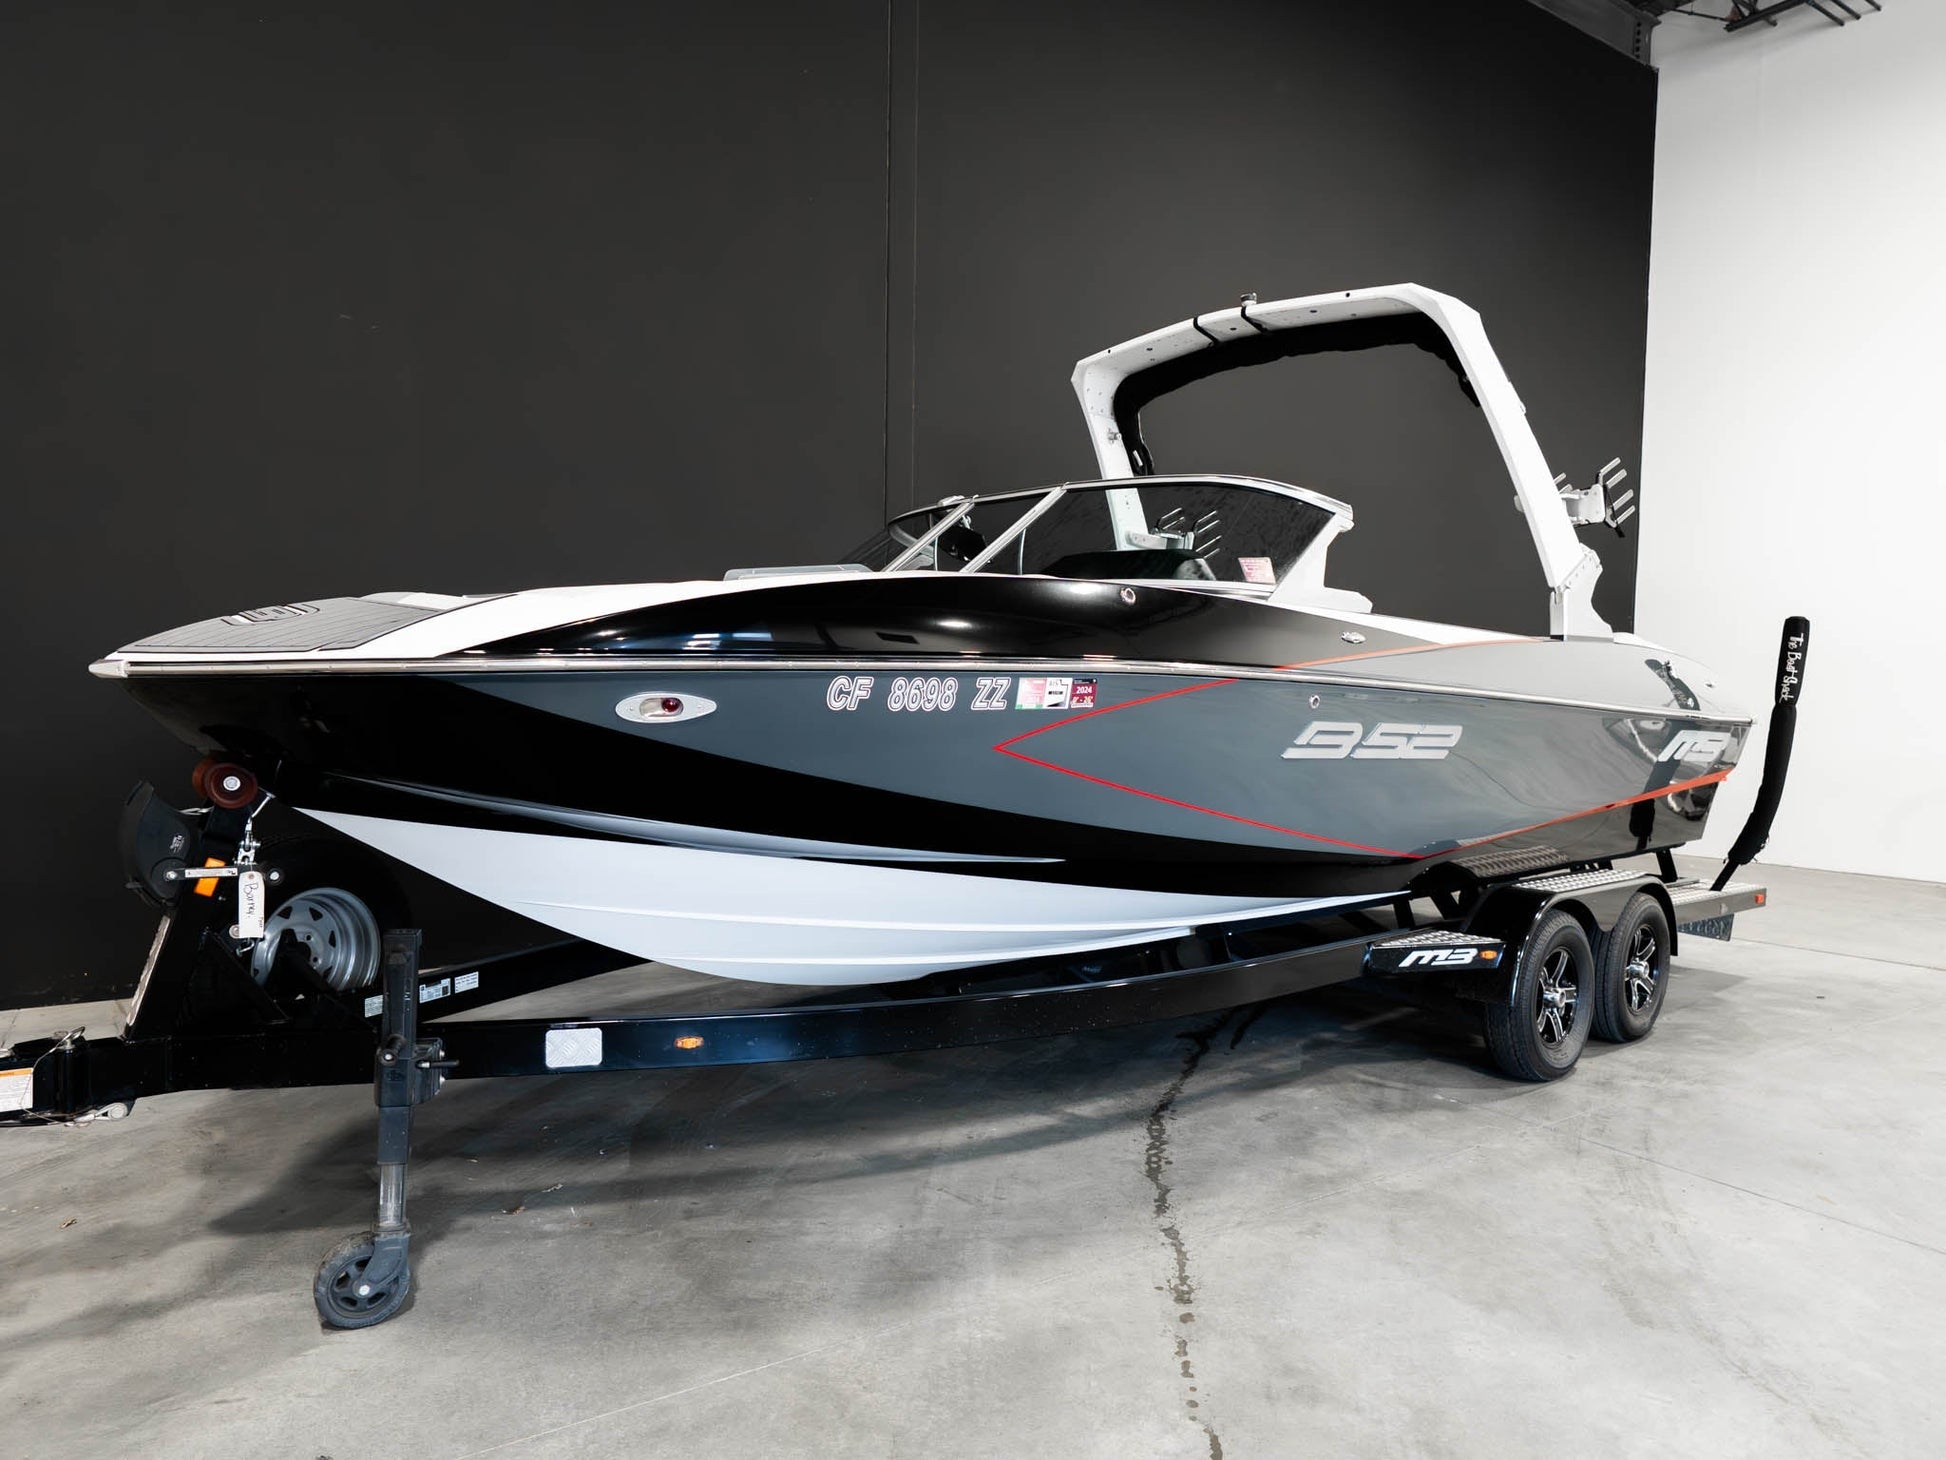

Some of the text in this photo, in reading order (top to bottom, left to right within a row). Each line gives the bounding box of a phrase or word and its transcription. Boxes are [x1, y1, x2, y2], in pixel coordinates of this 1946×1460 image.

[826, 676, 874, 711] CF
[887, 677, 958, 711] 8698
[971, 677, 1011, 710] ZZ
[1076, 686, 1093, 694] 2024
